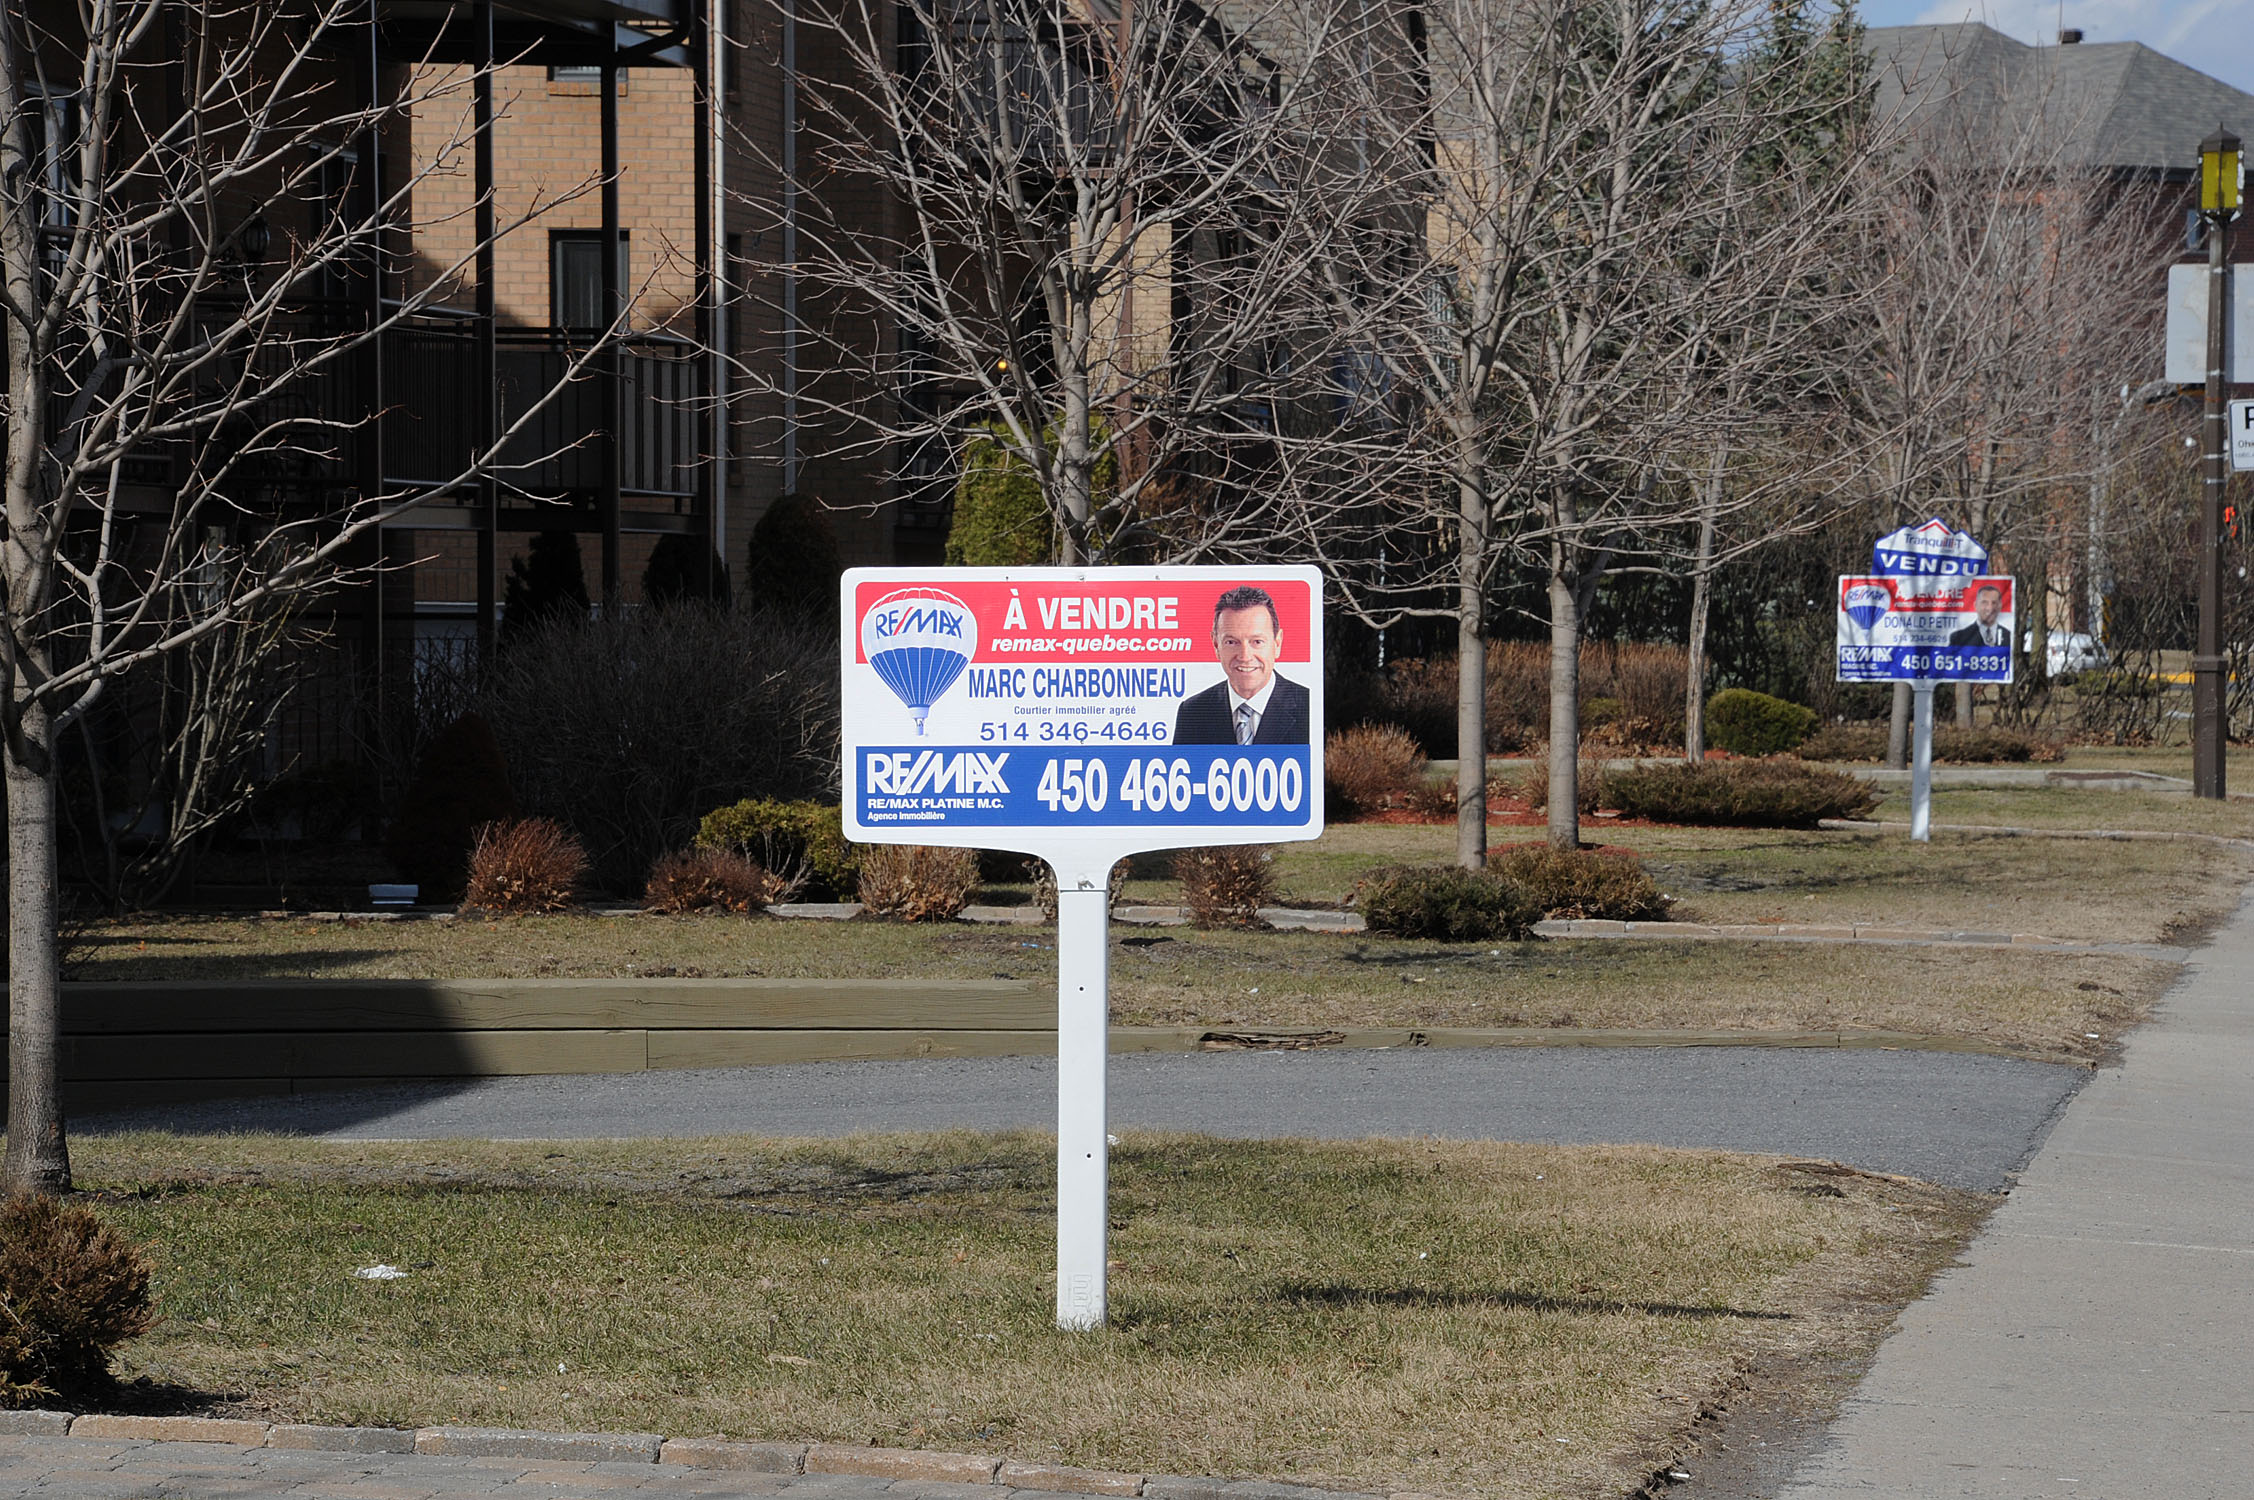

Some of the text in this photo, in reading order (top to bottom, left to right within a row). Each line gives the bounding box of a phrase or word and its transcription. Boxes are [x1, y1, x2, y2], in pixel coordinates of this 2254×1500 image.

[1880, 553, 1979, 576] VENDU
[1003, 588, 1179, 630] À VENDRE
[875, 606, 964, 639] RE/MAX
[1884, 616, 1957, 628] DONALD PETIT
[991, 634, 1192, 655] remax-quebec.com
[1841, 646, 1893, 662] RE/MAX
[1901, 654, 2007, 671] 450 651-8331
[968, 668, 1186, 698] MARC CHARBONNEAU
[1014, 705, 1052, 715] Courtier
[1109, 705, 1137, 717] agréé
[980, 721, 1168, 741] 514 346-4646
[866, 750, 1011, 796] RE/MAX
[1037, 757, 1303, 812] 450 466-6000
[867, 798, 1004, 809] RE/MAX PLATINE M.C.
[867, 811, 898, 822] Agence
